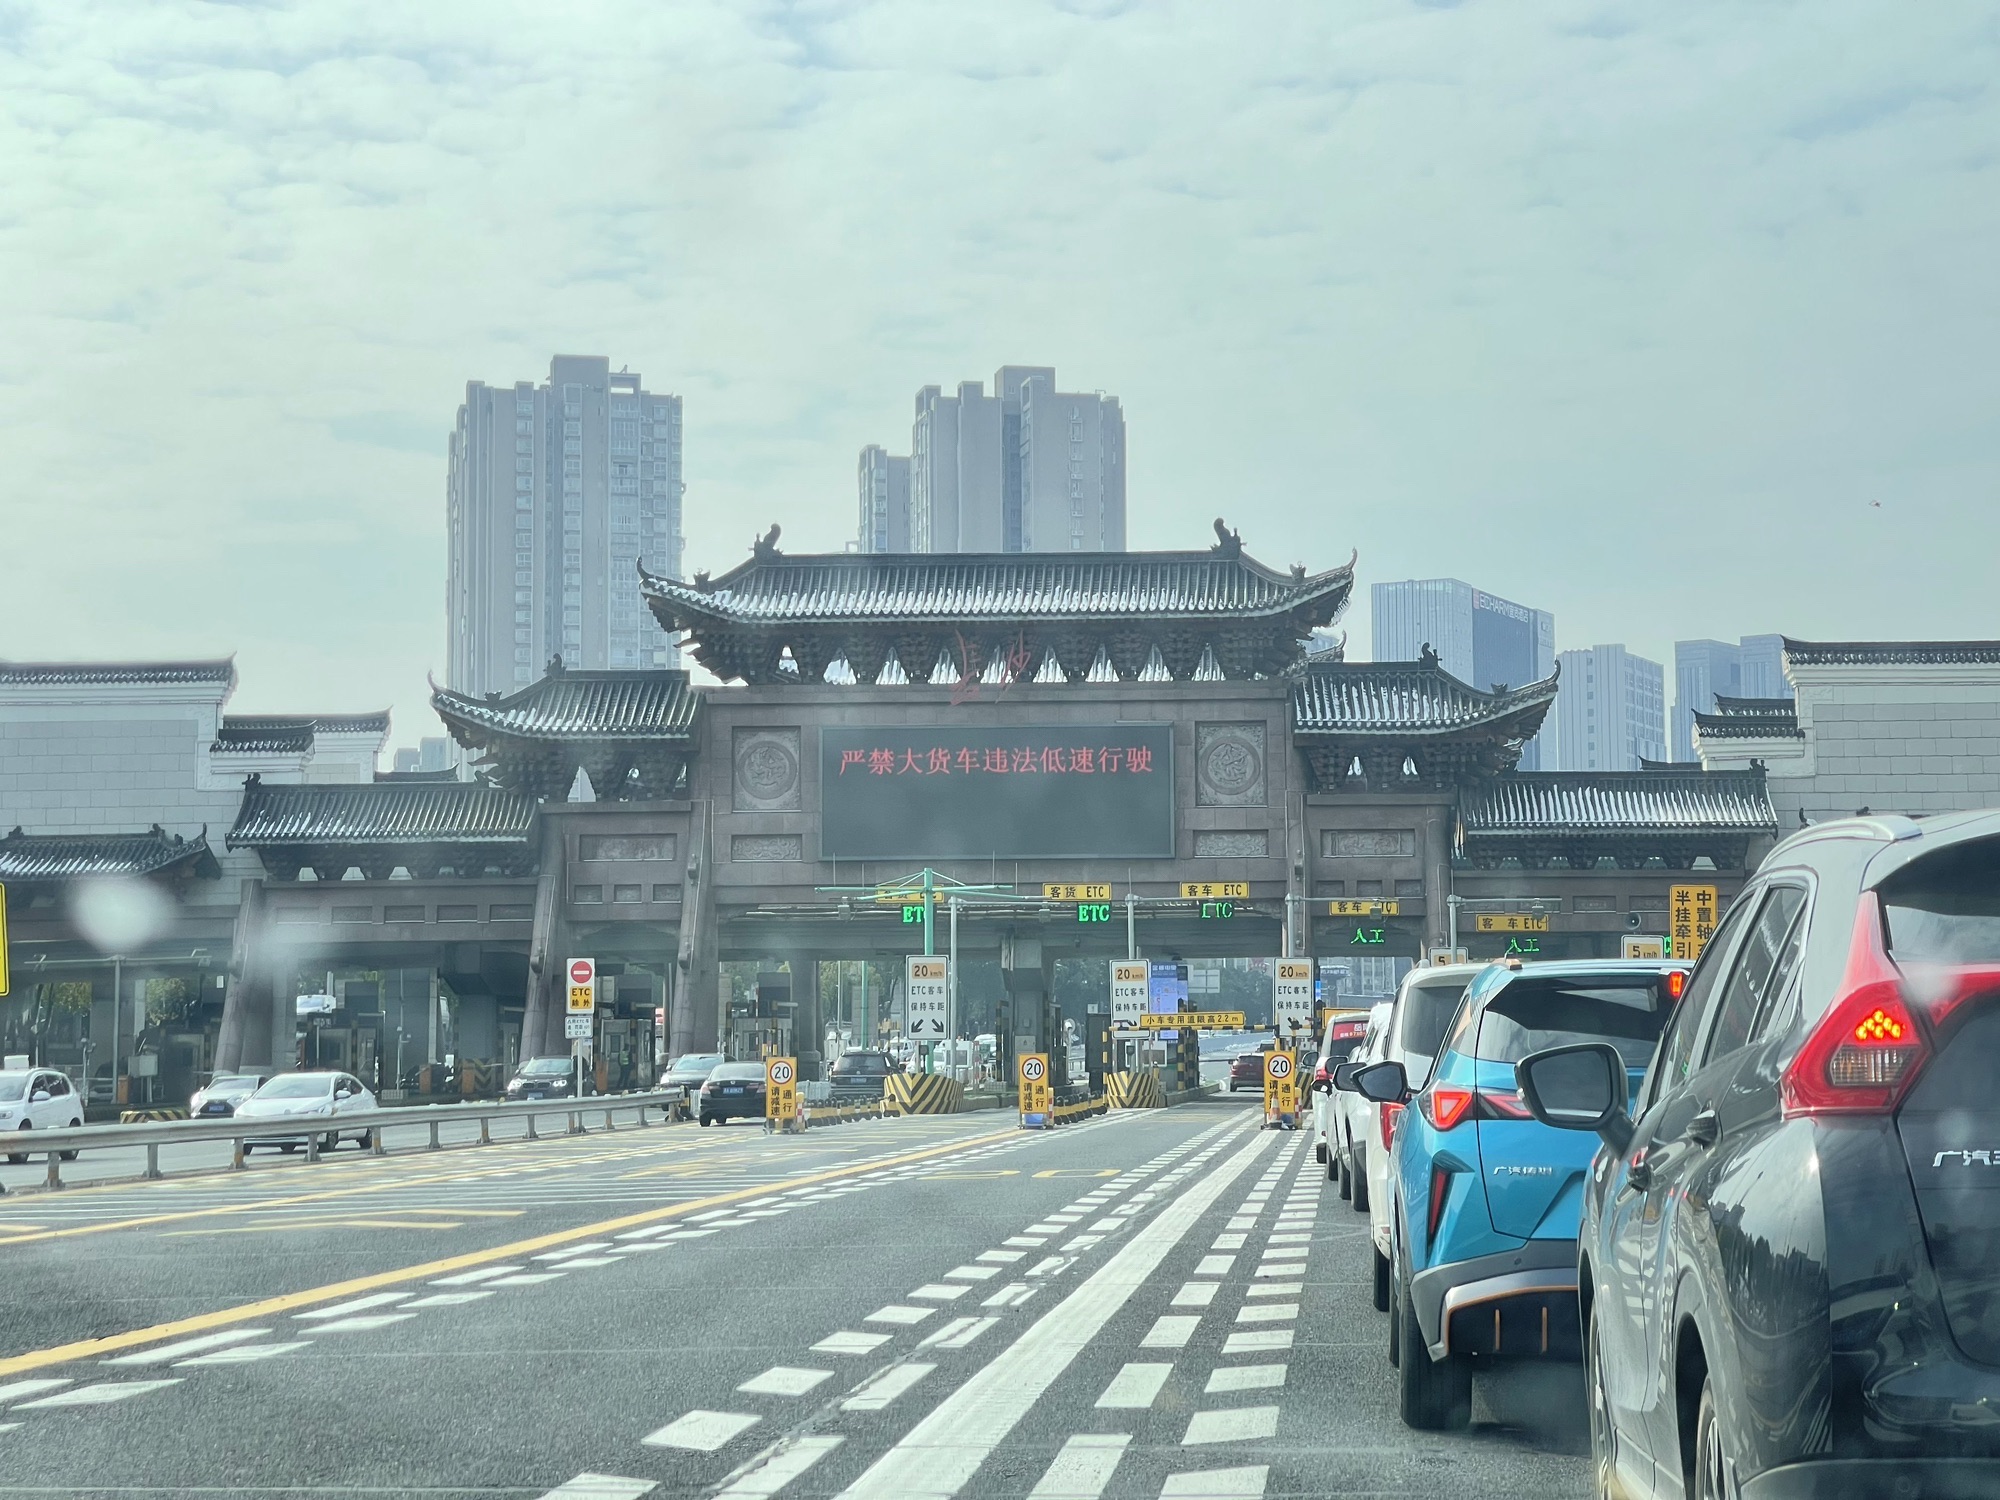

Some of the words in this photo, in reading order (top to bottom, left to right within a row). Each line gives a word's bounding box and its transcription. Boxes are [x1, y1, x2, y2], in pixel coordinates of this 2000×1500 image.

[838, 745, 1153, 778] 严禁大货车违法低速行驶
[1050, 886, 1076, 898] 客货
[1086, 886, 1105, 898] ETC
[1187, 885, 1213, 897] 客车
[1224, 884, 1242, 896] ETC
[903, 906, 926, 923] ET
[1078, 904, 1110, 922] ETC
[1482, 918, 1519, 930] 客车
[1675, 890, 1691, 959] 半挂牵引
[1350, 927, 1385, 945] 人工
[1507, 937, 1540, 952] 人工
[1632, 945, 1641, 959] 5
[914, 965, 928, 977] 20
[1117, 969, 1130, 980] 20
[1280, 966, 1294, 978] 20
[571, 988, 590, 996] ETC
[911, 985, 944, 995] ETC客车
[1115, 987, 1145, 997] ETC客车
[1277, 986, 1309, 995] ETC客车
[911, 1002, 945, 1012] 保持车距
[1115, 1003, 1147, 1012] 保持车距
[1277, 1001, 1310, 1010] 保持车距
[774, 1066, 790, 1079] 20
[1026, 1062, 1042, 1076] 20
[1272, 1060, 1288, 1073] 20
[771, 1086, 780, 1116] 请减速
[782, 1089, 792, 1113] 通行
[1023, 1082, 1033, 1112] 请减速
[1035, 1085, 1045, 1108] 通行
[1281, 1083, 1291, 1107] 通行
[1932, 1149, 2000, 1167] 广汽
